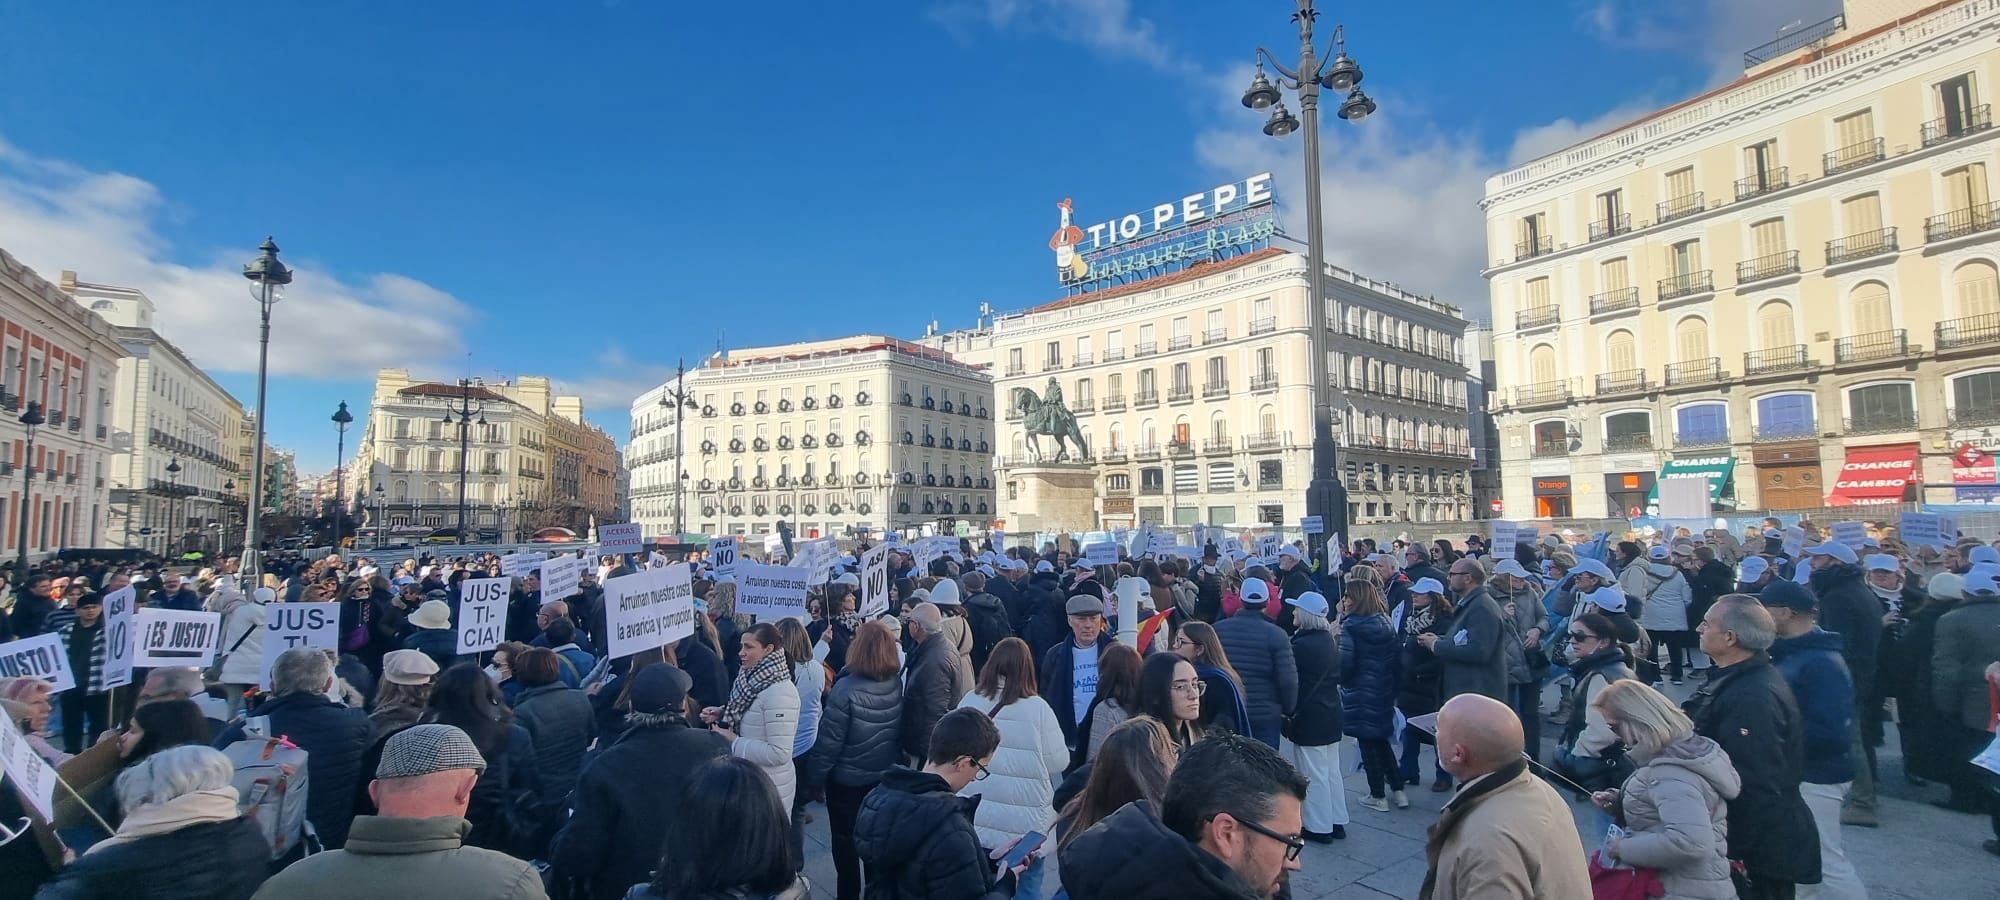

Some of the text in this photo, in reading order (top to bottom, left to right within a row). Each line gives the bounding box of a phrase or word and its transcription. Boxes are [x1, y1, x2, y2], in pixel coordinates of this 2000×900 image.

[1088, 172, 1272, 249] TIO PEPE
[1207, 219, 1275, 250] BYASS
[1672, 457, 1729, 467] CHANGE
[1844, 460, 1913, 471] CHANGE
[1538, 480, 1568, 489] Orange
[1836, 479, 1905, 488] CAMBIO
[606, 527, 635, 536] ACERAS
[716, 549, 734, 567] NO
[1264, 546, 1277, 557] NO
[745, 575, 807, 590] Arruinan nuestra costa
[867, 568, 883, 604] NO
[464, 583, 507, 603] JUS-
[619, 582, 691, 612] Arruinan nuestra costa
[741, 592, 746, 603] la
[747, 593, 769, 605] avaricia
[268, 609, 335, 631] JUS-
[474, 606, 495, 624] TI-
[143, 621, 214, 650] ¡ES JUSTO!
[464, 626, 501, 647] CIA!
[617, 622, 625, 640] la
[626, 616, 656, 639] avaricia
[656, 616, 661, 636] y
